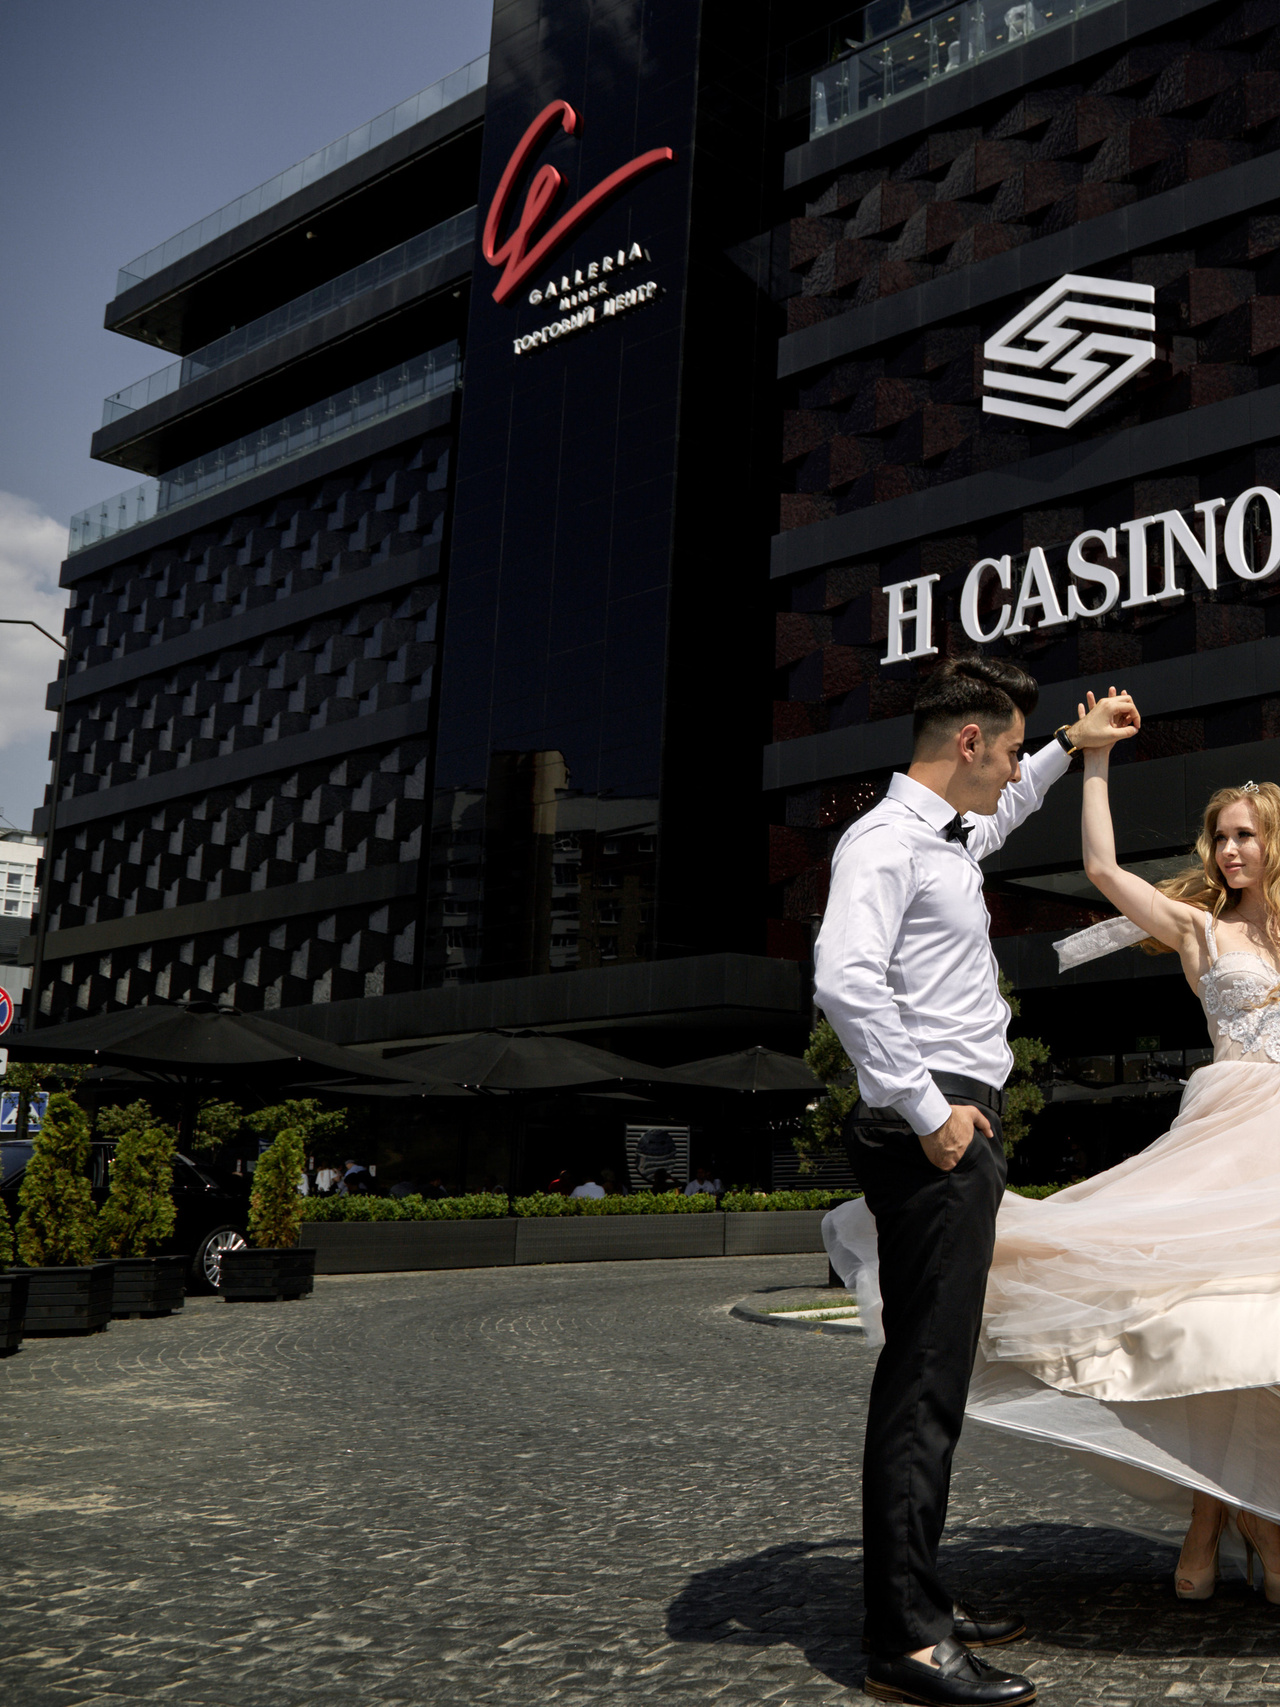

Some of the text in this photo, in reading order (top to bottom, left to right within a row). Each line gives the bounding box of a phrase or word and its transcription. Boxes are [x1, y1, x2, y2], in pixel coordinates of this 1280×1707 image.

[529, 242, 643, 306] GALLERIA
[559, 281, 609, 312] MINSK
[513, 281, 658, 355] ТОРГОВЫЙ ЦЕНТР
[880, 573, 941, 665] H
